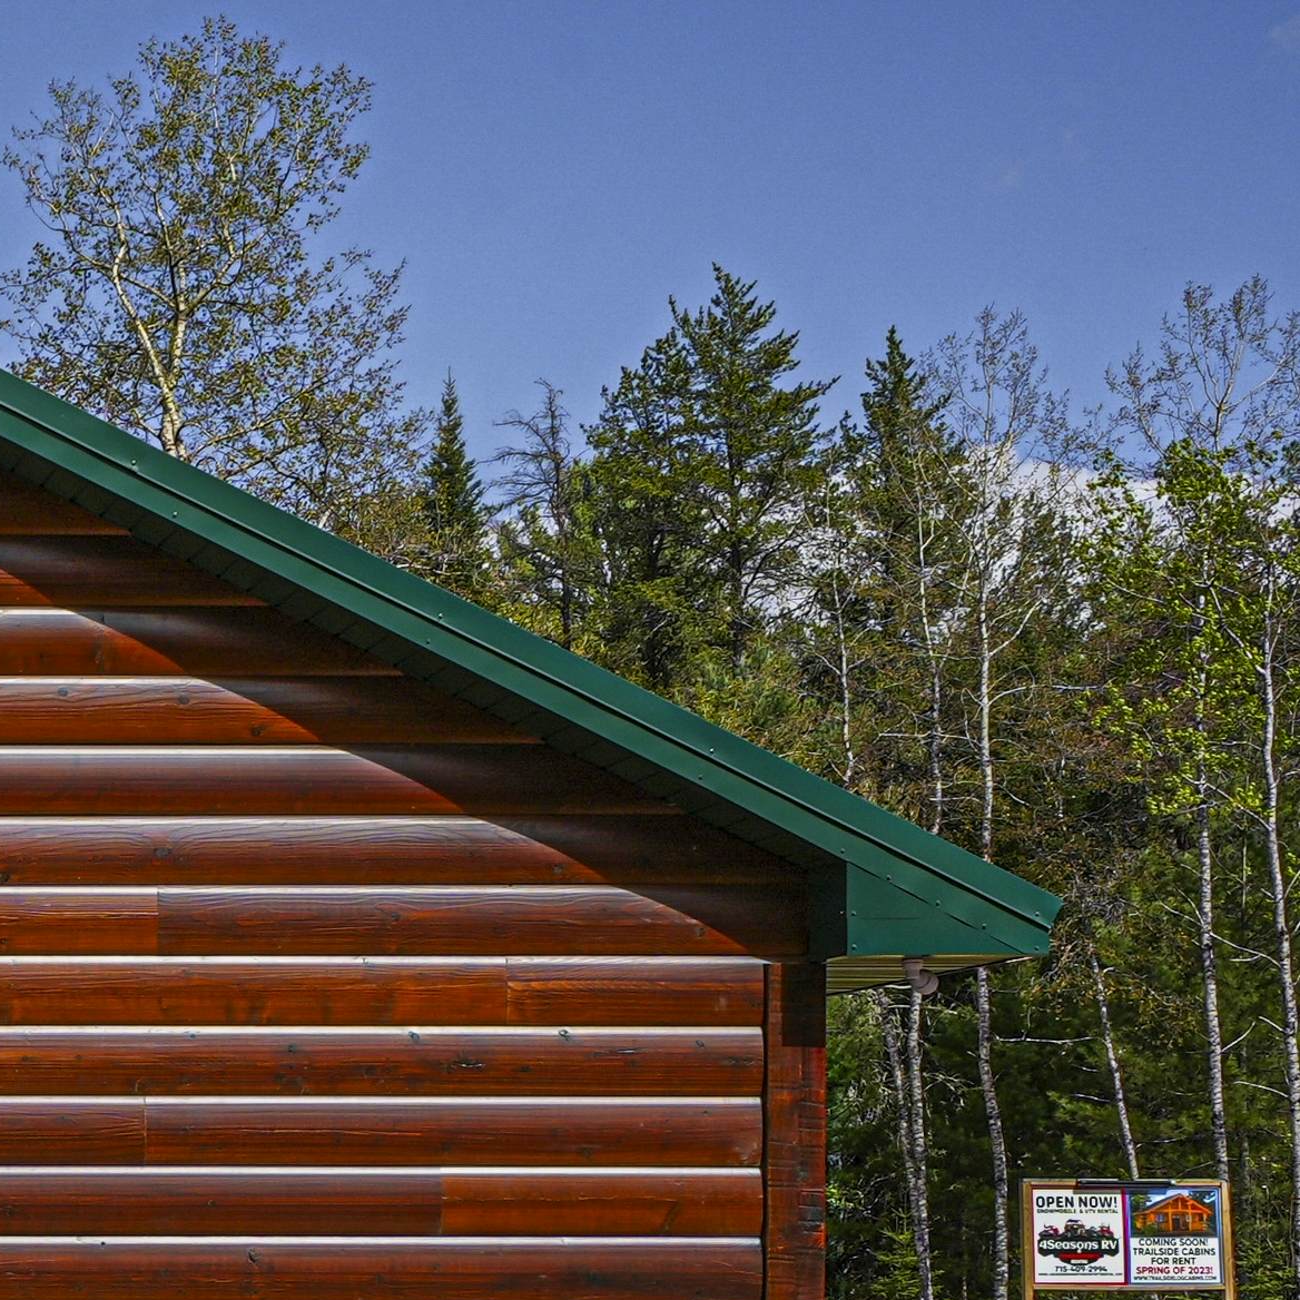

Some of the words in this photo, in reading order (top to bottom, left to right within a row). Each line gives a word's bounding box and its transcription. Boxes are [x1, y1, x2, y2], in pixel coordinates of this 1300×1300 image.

[1035, 1196, 1074, 1208] OPEN
[1078, 1196, 1117, 1208] NOW!
[1039, 1239, 1099, 1250] 4Seasons
[1101, 1239, 1118, 1250] RV
[1138, 1238, 1177, 1246] COMING
[1179, 1238, 1208, 1246] SOON!
[1133, 1247, 1179, 1256] TRAILSIDE
[1181, 1247, 1216, 1256] CABINS
[1151, 1257, 1169, 1265] FOR
[1172, 1257, 1196, 1265] RENT
[1135, 1266, 1171, 1274] SPRING
[1172, 1266, 1186, 1274] OF
[1188, 1266, 1214, 1274] 2023!
